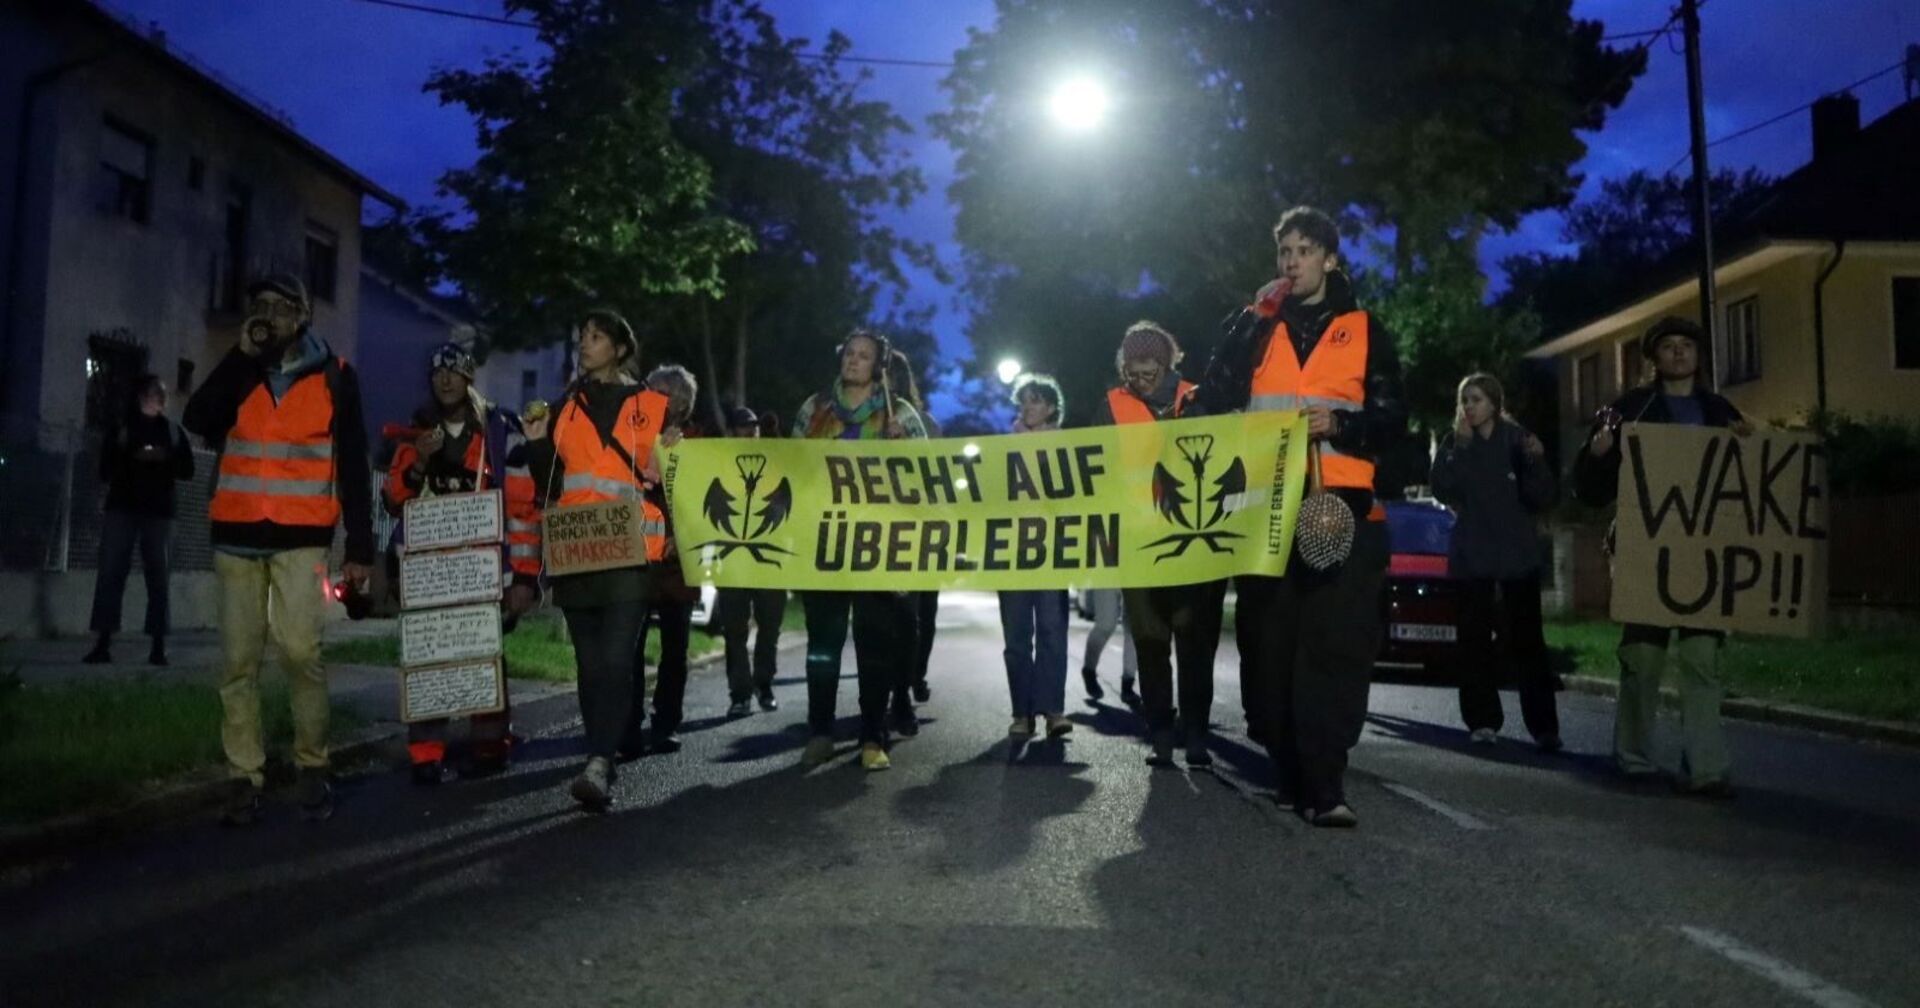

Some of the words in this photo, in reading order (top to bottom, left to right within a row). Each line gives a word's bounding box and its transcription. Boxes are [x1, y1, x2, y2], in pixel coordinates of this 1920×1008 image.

[824, 453, 983, 505] RECHT
[1006, 445, 1106, 502] AUF
[1628, 435, 1827, 540] WAKE
[605, 505, 631, 521] UNS
[611, 521, 629, 536] DIE
[814, 510, 1121, 572] ÜBERLEBEN
[1268, 514, 1282, 555] LETZTE
[1657, 545, 1804, 619] UP!!
